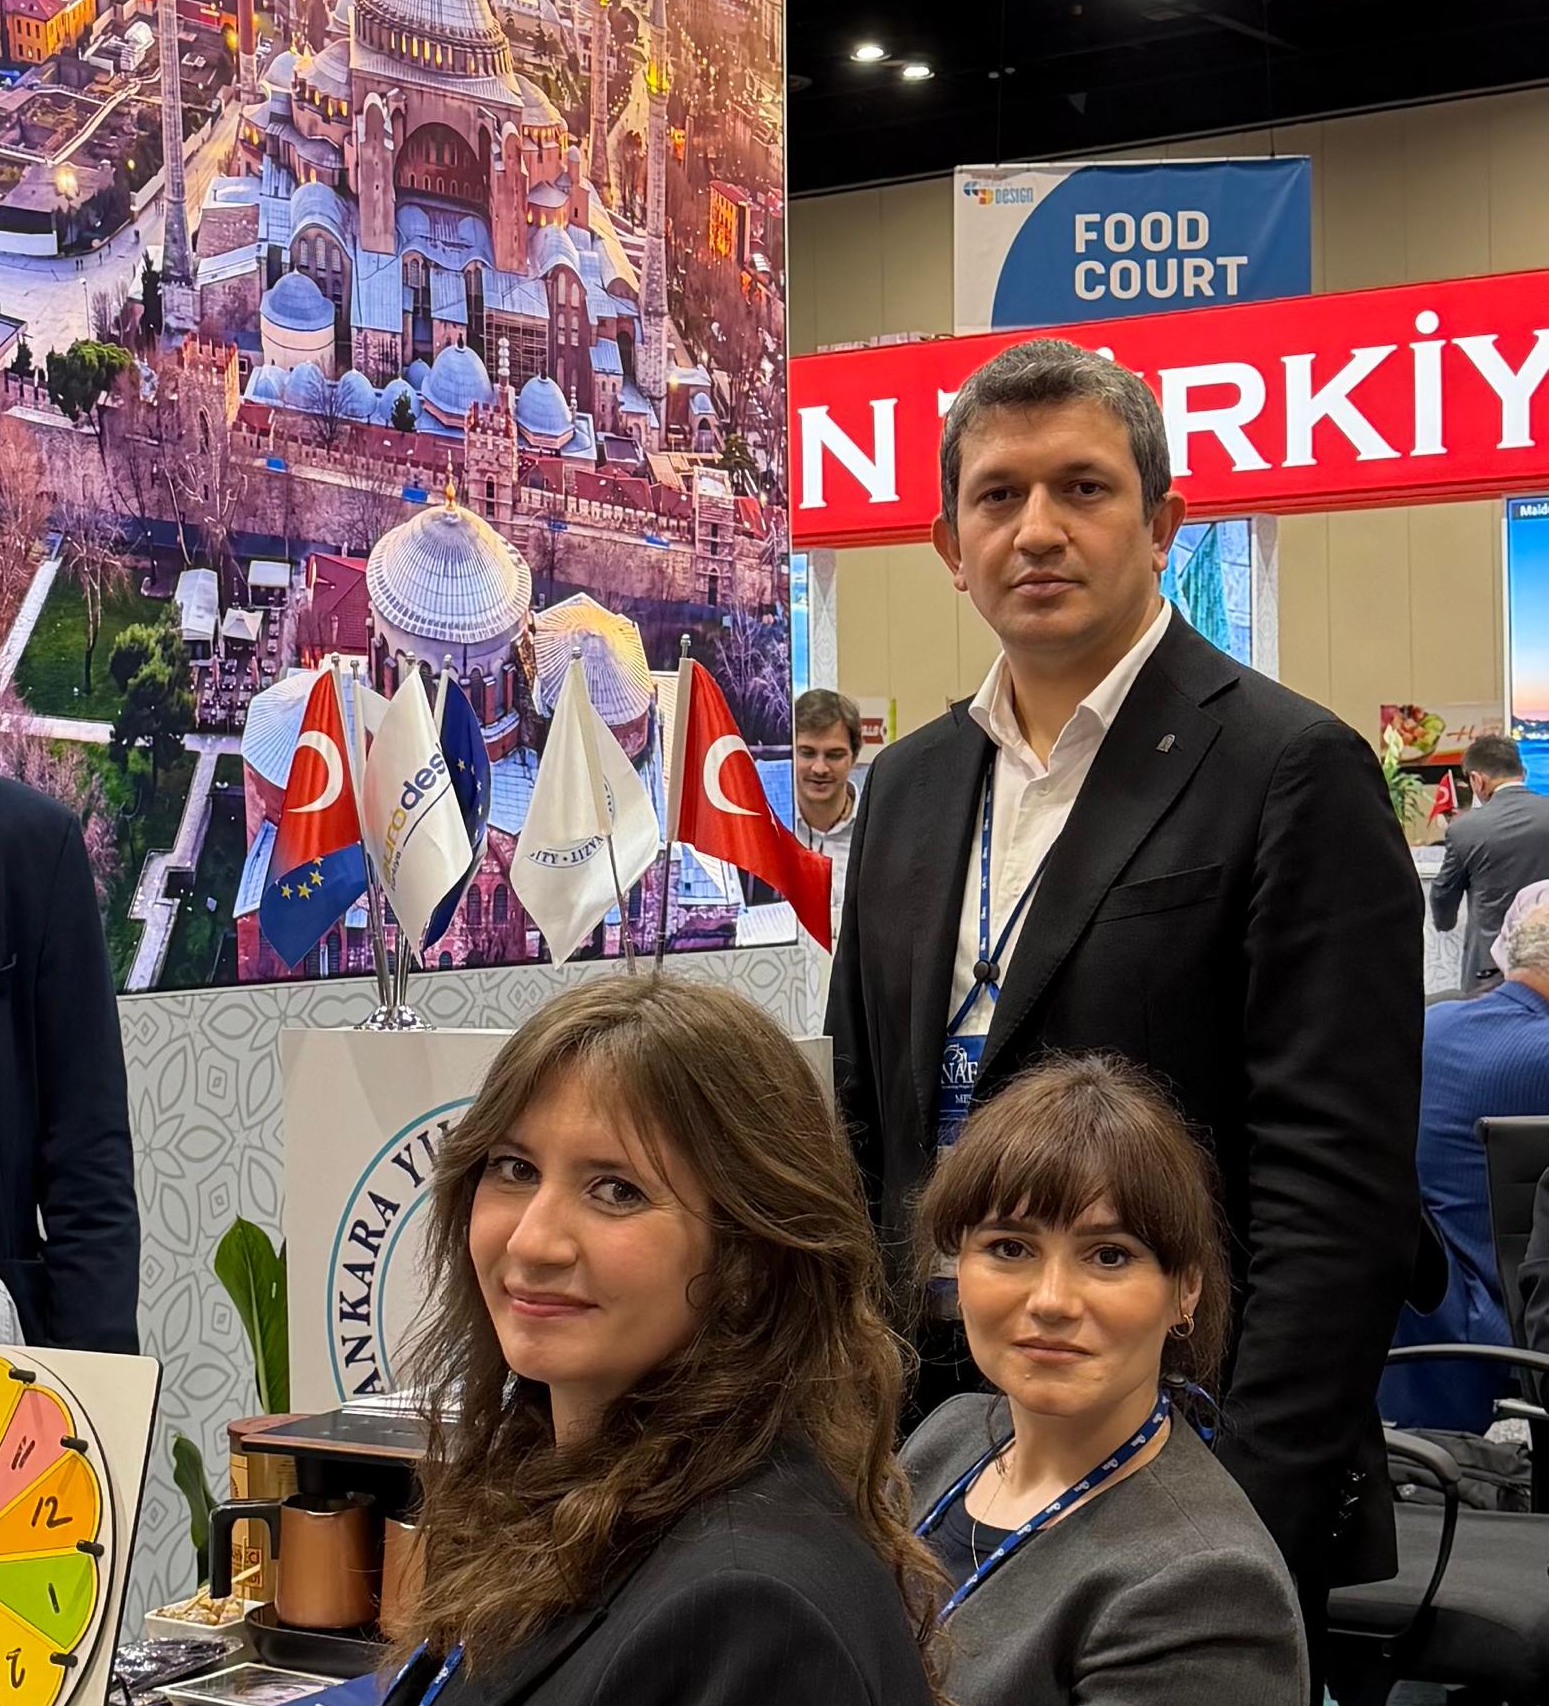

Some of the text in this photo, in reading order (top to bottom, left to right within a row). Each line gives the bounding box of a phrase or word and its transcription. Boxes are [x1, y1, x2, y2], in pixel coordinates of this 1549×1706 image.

[1075, 210, 1209, 253] FOOD
[1074, 256, 1248, 301] COURT
[1520, 502, 1549, 517] Maid
[382, 742, 447, 884] eurodes
[339, 1190, 401, 1395] ANKARA
[11, 1436, 35, 1470] 11
[31, 1495, 73, 1529] 12
[48, 1582, 60, 1614] 1
